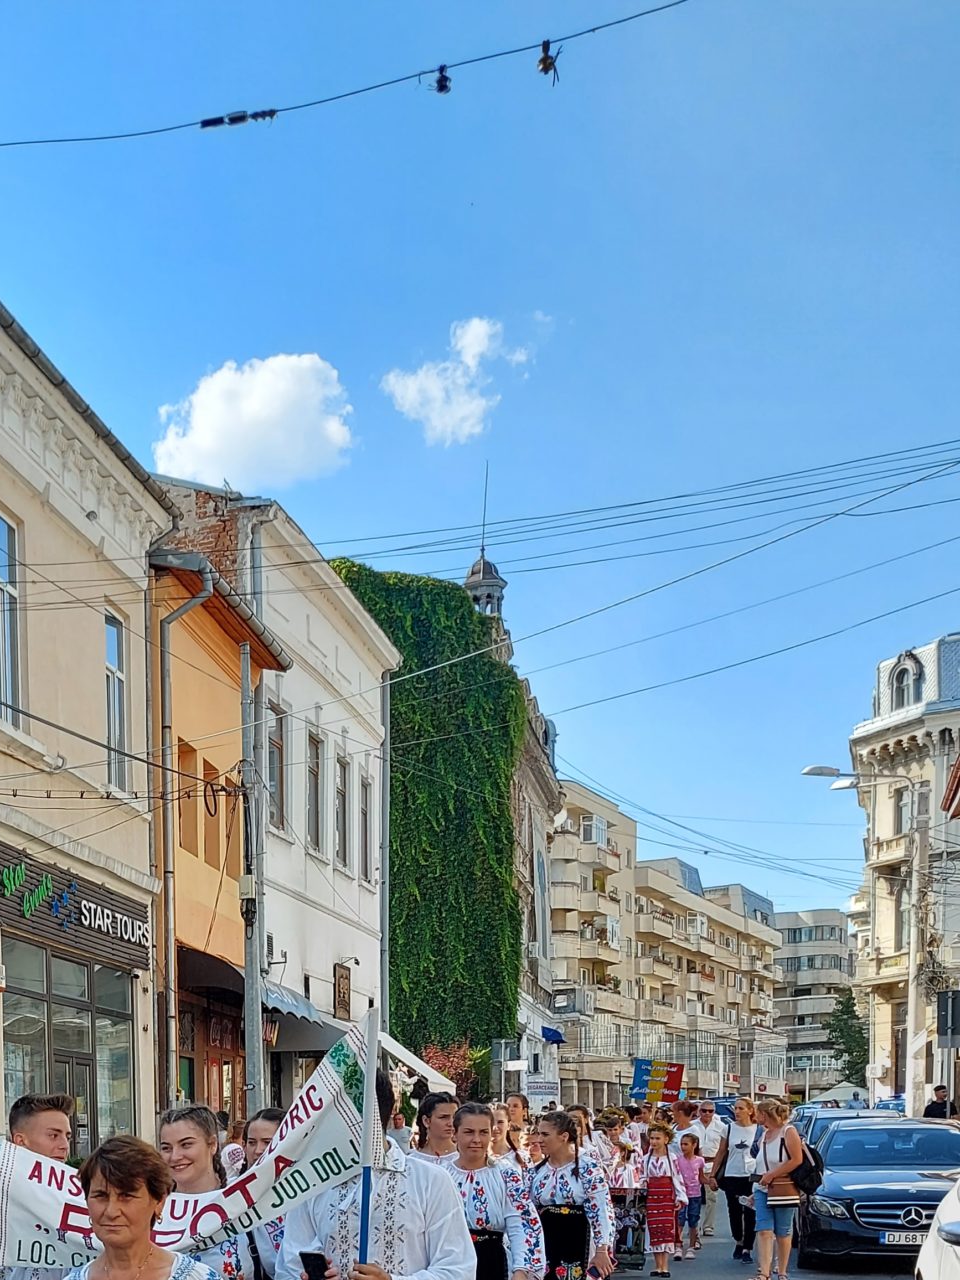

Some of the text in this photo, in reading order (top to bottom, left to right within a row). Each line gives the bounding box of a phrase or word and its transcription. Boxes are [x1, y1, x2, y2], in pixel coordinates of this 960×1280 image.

[2, 862, 26, 897] Star
[81, 899, 151, 948] STAR TOURS
[16, 1239, 64, 1268] LOC.
[270, 1168, 317, 1209] JUD.
[309, 1138, 361, 1183] DOLJ
[887, 1233, 902, 1243] DJ
[904, 1233, 918, 1244] 68
